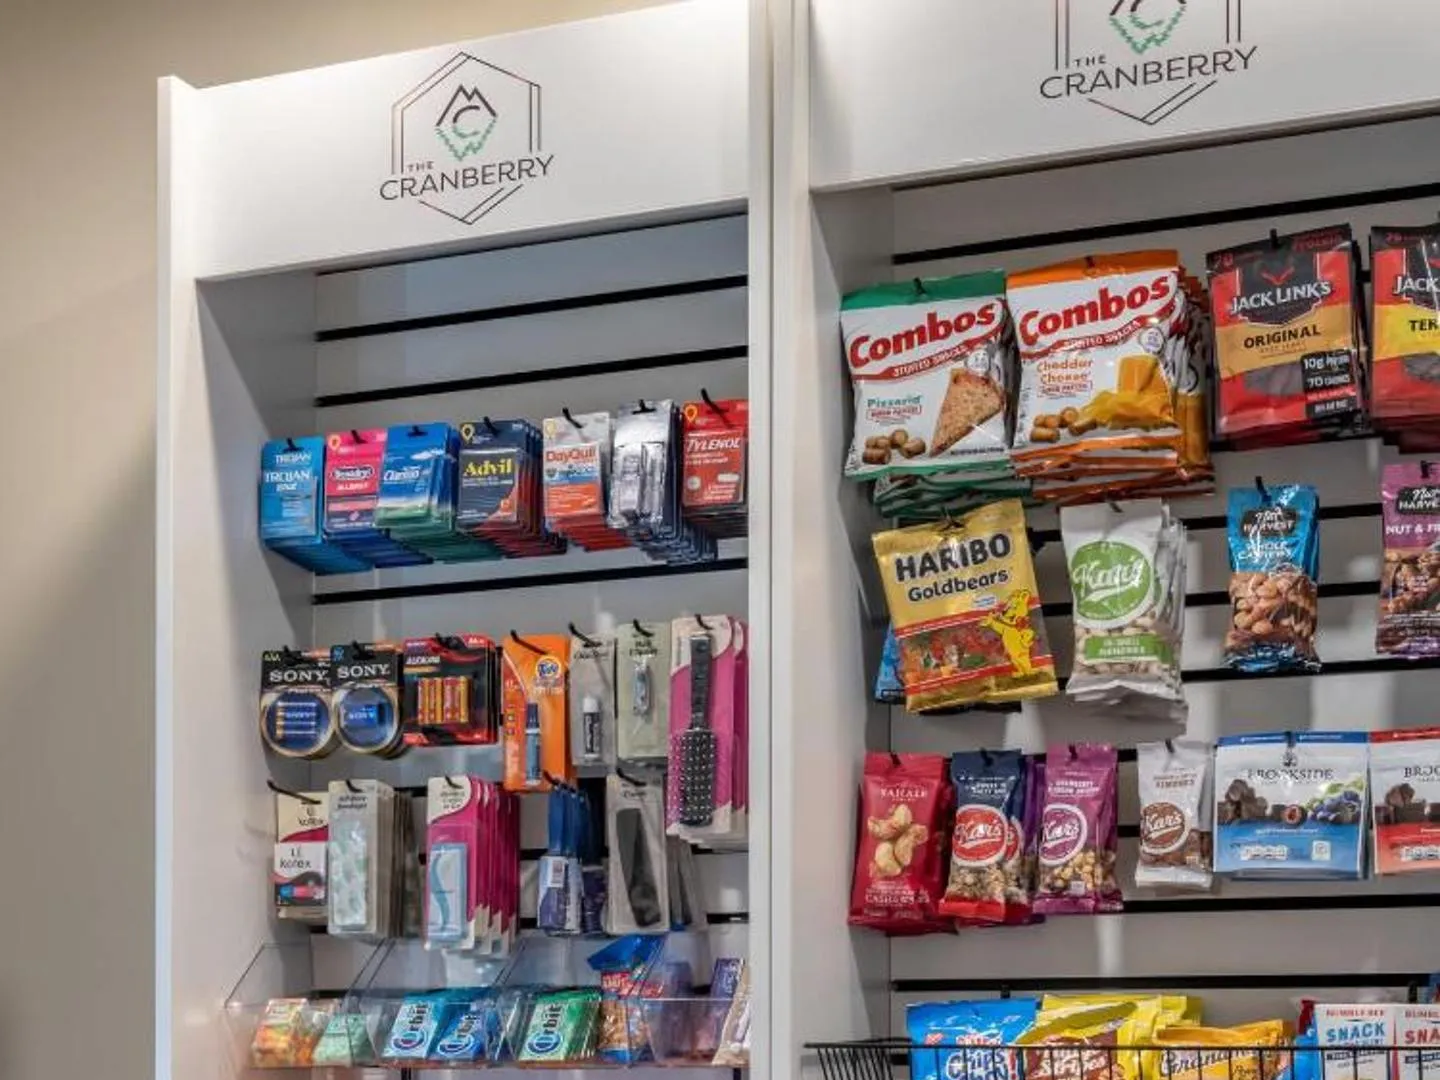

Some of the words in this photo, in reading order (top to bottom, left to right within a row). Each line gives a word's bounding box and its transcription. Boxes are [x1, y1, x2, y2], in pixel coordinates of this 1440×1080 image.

[1075, 54, 1106, 67] THE
[1040, 46, 1258, 99] CRANBERRY
[407, 161, 434, 172] THE
[379, 154, 554, 201] CRANBERRY
[1018, 274, 1171, 346] Combos
[1231, 292, 1275, 313] JACK
[849, 301, 996, 368] Combos
[1244, 324, 1321, 349] ORIGINAL
[1036, 358, 1093, 371] Cheddar
[1039, 372, 1090, 382] Cheese
[686, 439, 741, 450] TYLENOL
[545, 447, 595, 462] DayQuil
[264, 470, 310, 482] TROJAN
[463, 458, 512, 477] Advil
[1386, 523, 1410, 535] NUT
[895, 532, 1012, 583] HARIBO
[908, 568, 1009, 602] Goldbears
[270, 670, 329, 683] SONY
[337, 664, 391, 679] SONY
[1326, 1022, 1385, 1042] SNACK
[946, 1049, 1005, 1080] Chips
